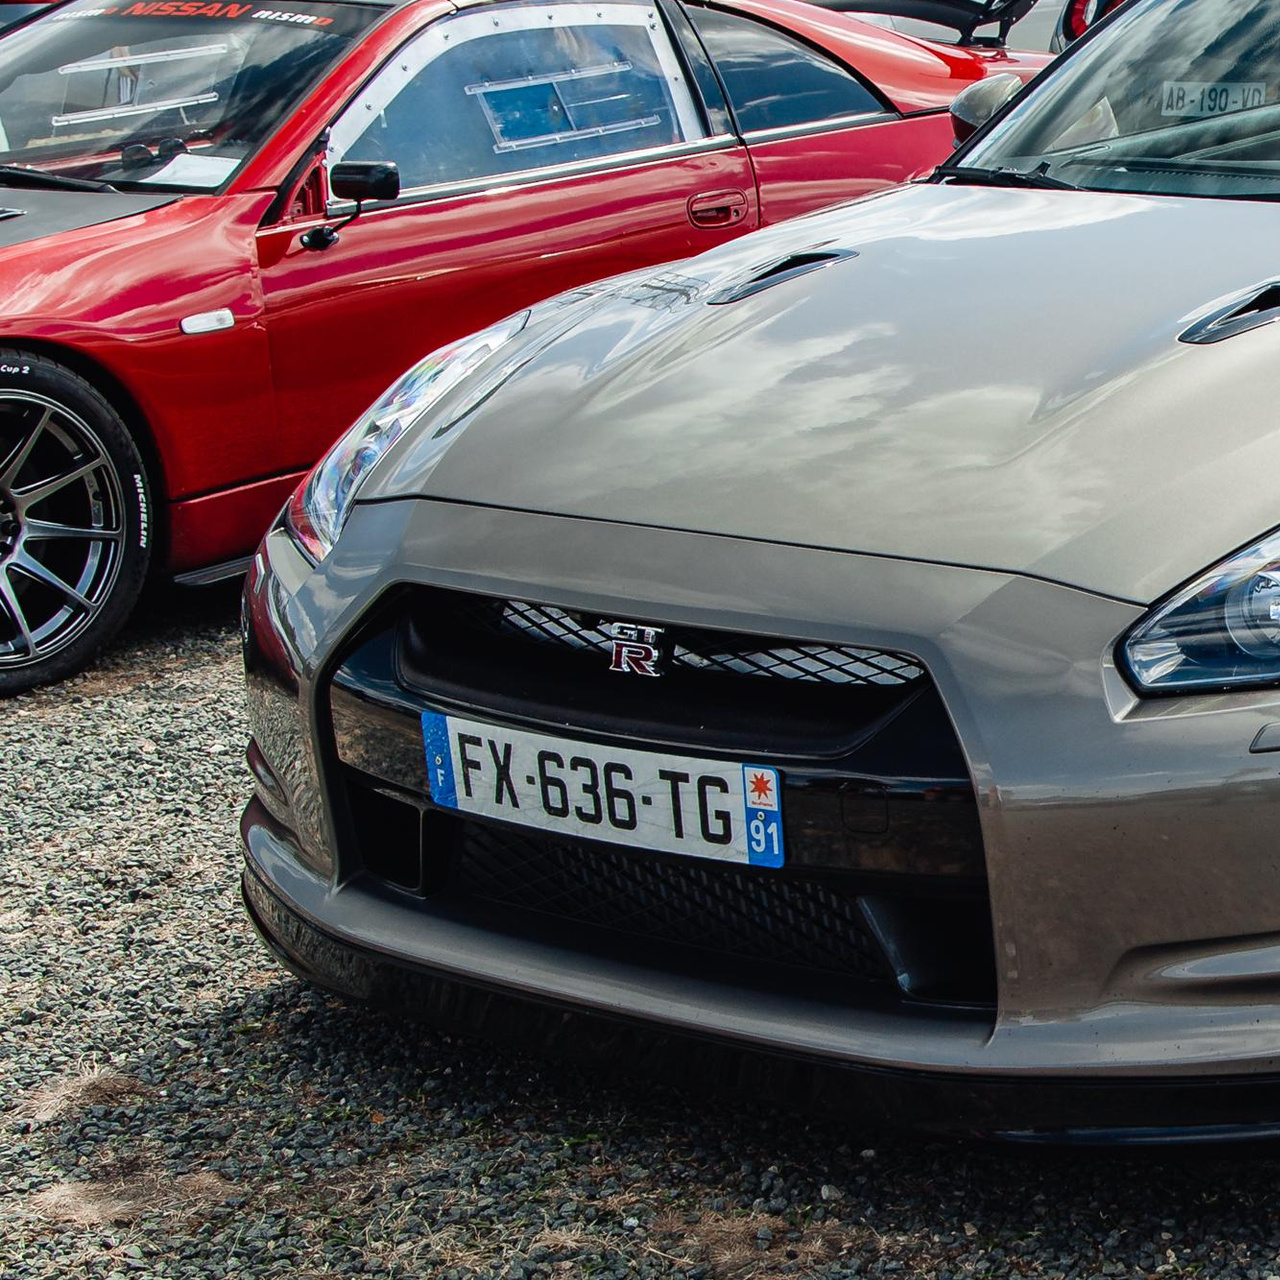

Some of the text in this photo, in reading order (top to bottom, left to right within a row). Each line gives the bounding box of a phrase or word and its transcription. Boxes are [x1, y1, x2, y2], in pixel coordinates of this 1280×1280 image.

[120, 1, 253, 19] NISSAN
[251, 9, 334, 27] nismo
[1165, 86, 1263, 113] AB-190-VD
[0, 364, 30, 375] Cup 2
[133, 473, 148, 549] MICHELIN
[436, 731, 780, 855] F FX-636-TG 91
